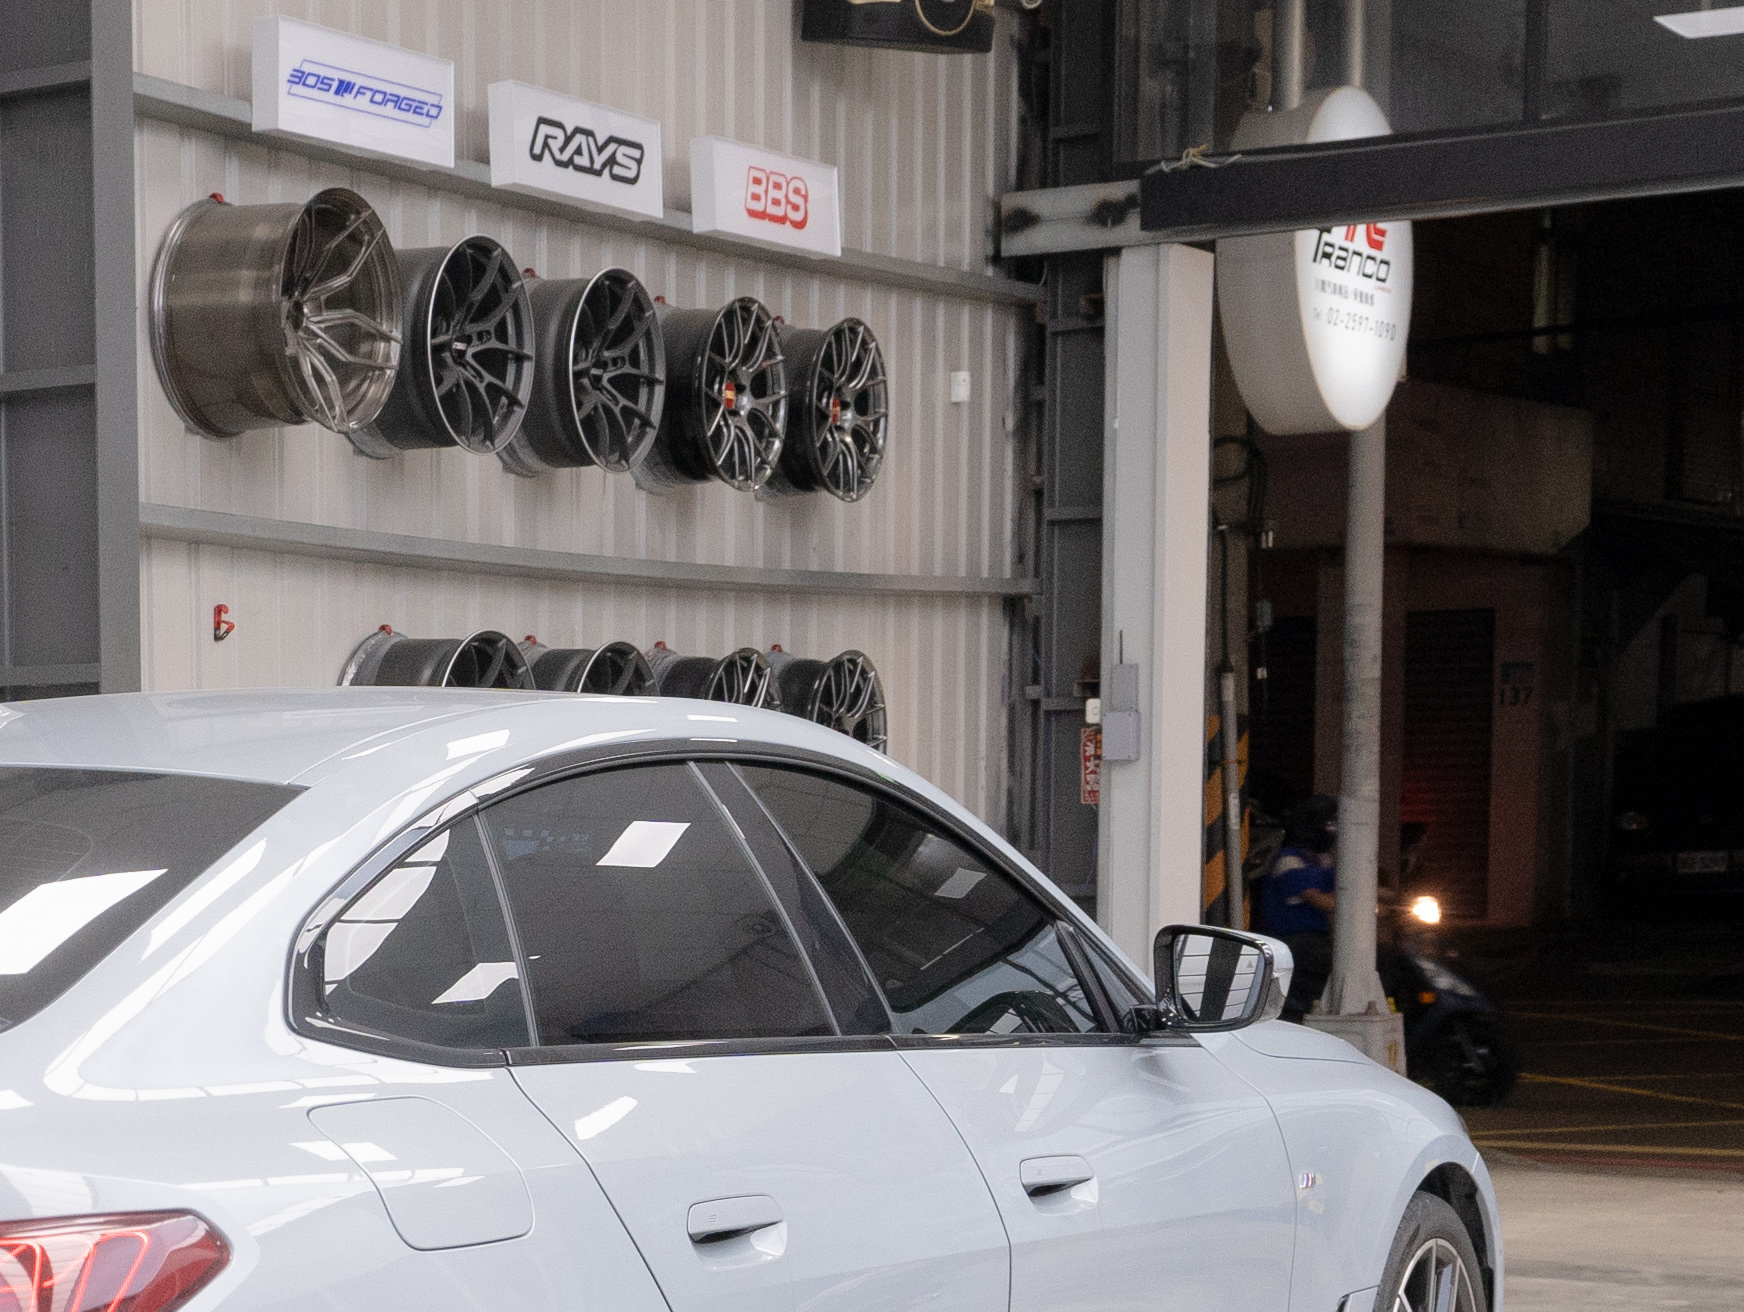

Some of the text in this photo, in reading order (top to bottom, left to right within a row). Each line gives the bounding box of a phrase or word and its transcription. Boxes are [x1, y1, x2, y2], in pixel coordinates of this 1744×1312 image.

[354, 85, 443, 119] FORGED
[529, 116, 644, 185] RAYS
[745, 166, 808, 230] BBS
